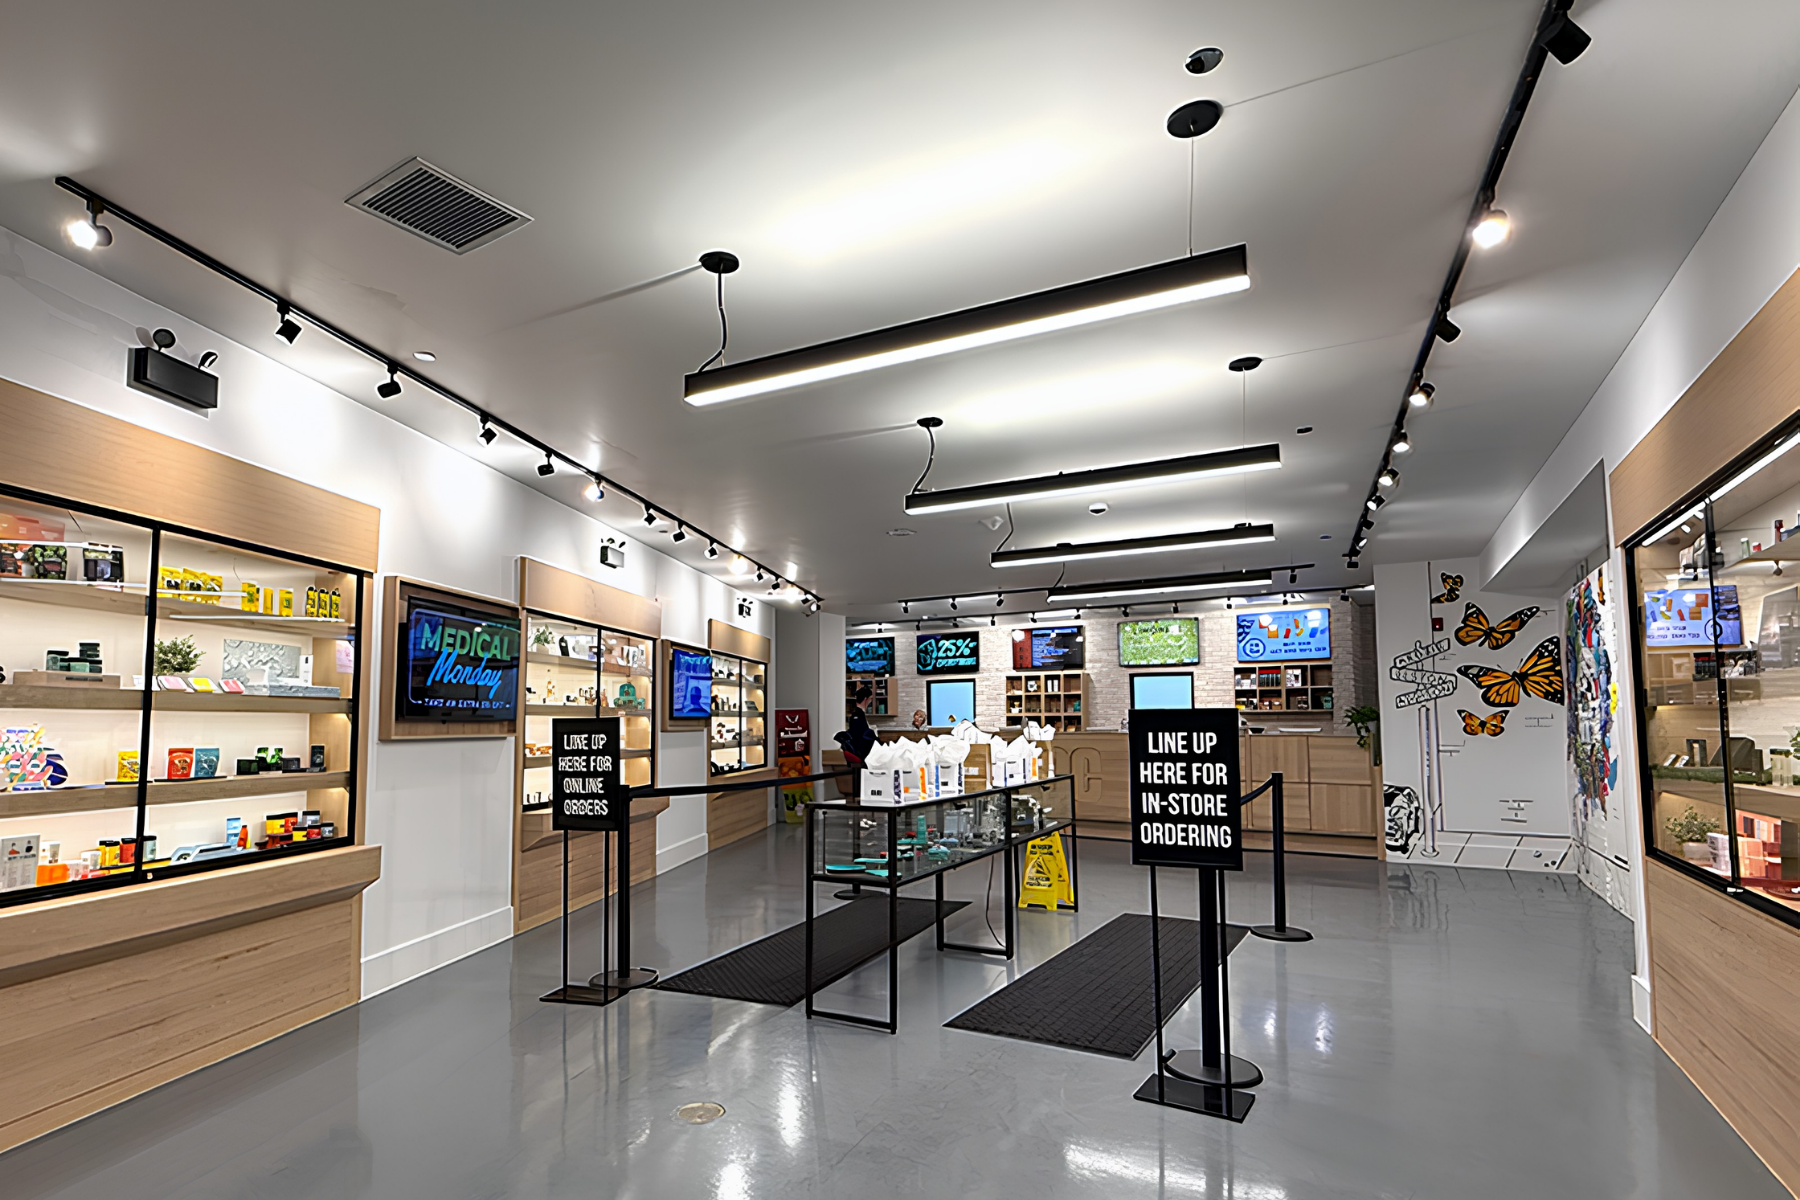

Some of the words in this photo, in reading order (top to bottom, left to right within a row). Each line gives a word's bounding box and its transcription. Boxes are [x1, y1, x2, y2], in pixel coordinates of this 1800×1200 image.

[420, 622, 511, 661] MEDICAL
[938, 638, 971, 657] 25%
[426, 648, 502, 699] Monday
[563, 733, 589, 750] LINE
[591, 734, 607, 750] UP
[1147, 731, 1188, 754] LINE
[1193, 732, 1218, 754] UP
[558, 756, 587, 772] HERE
[590, 756, 613, 772] FOR
[1140, 762, 1187, 785] HERE
[1192, 762, 1228, 786] FOR
[563, 777, 605, 794] ONLINE
[563, 799, 609, 816] ORDERS
[1142, 792, 1228, 817] IN-STORE
[1140, 822, 1232, 849] ORDERING
